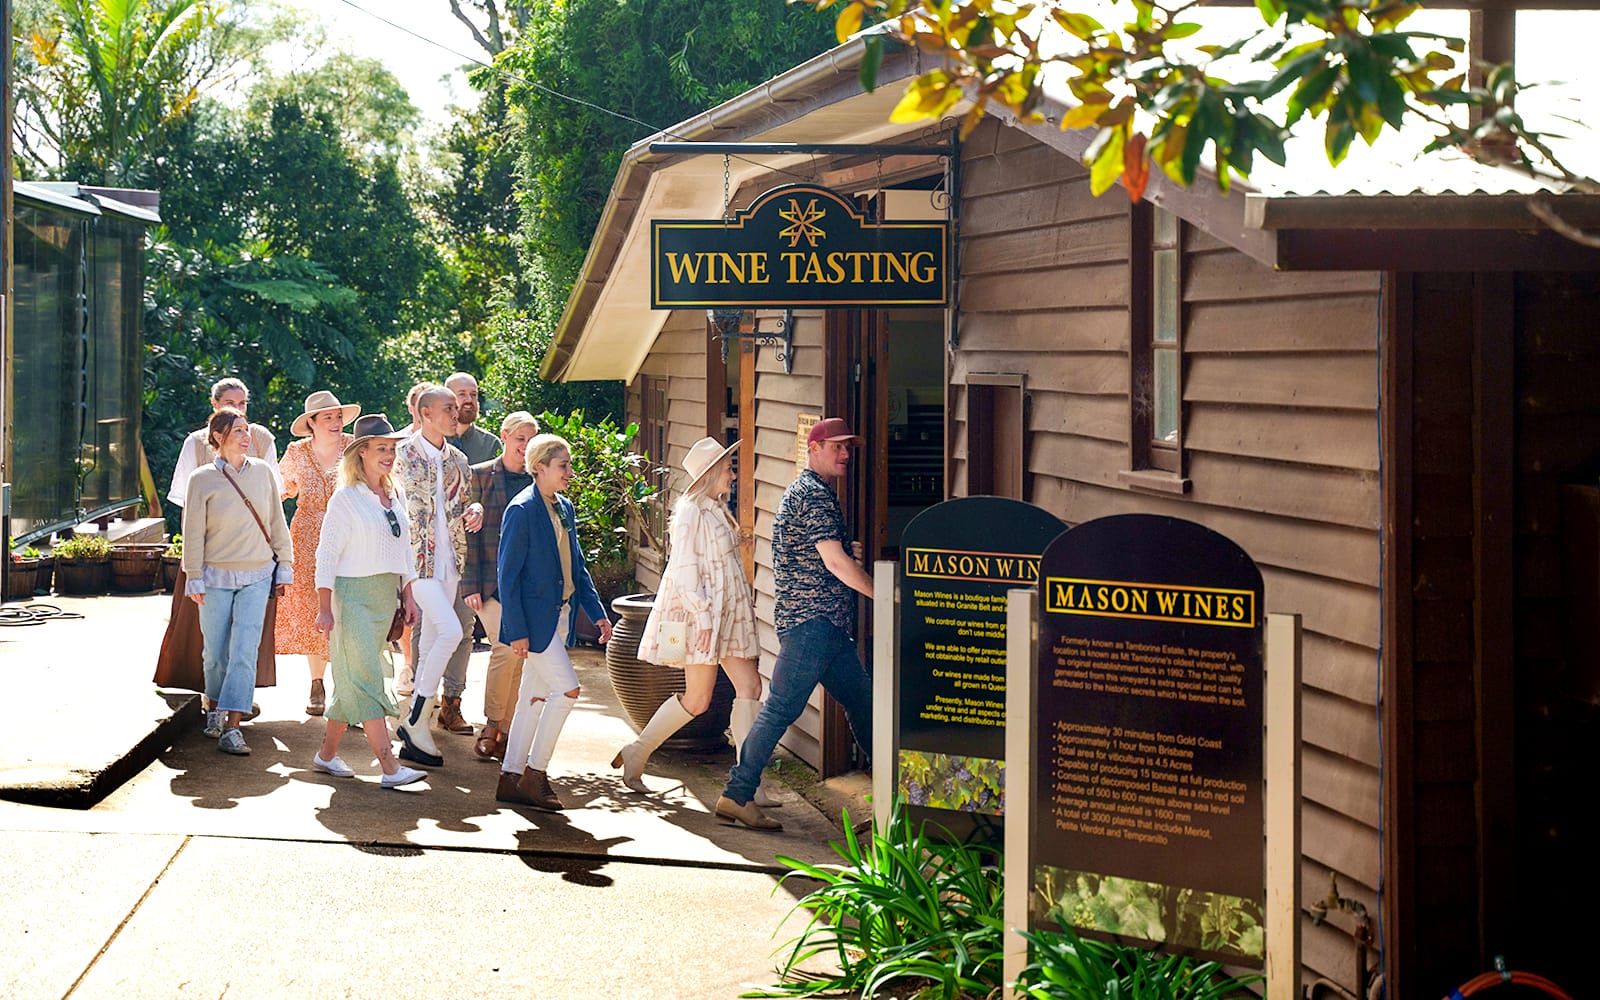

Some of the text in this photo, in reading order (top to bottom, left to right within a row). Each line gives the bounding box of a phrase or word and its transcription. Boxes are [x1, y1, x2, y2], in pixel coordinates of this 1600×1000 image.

[665, 252, 937, 284] WINE TASTING
[914, 553, 1040, 579] MASON WIN
[914, 590, 934, 598] Mason
[934, 592, 952, 600] Wines
[966, 595, 990, 603] boutique
[916, 600, 938, 608] situated
[956, 602, 978, 610] Granite
[979, 603, 990, 611] Belt
[1055, 584, 1245, 621] MASON WINES
[925, 617, 935, 625] We
[986, 630, 1005, 638] middle
[925, 643, 935, 651] We
[1053, 647, 1078, 656] location
[1088, 650, 1108, 658] known
[1121, 653, 1129, 661] Mt
[1173, 659, 1194, 667] oldest
[1062, 636, 1090, 647] Formerly
[1092, 640, 1113, 648] known
[1188, 649, 1199, 657] the
[936, 654, 966, 662] obtainable
[975, 655, 990, 663] retail
[932, 669, 944, 677] Our
[1067, 660, 1090, 669] original
[1140, 666, 1156, 675] back
[1188, 670, 1201, 679] The
[1203, 672, 1216, 681] fruit
[962, 682, 980, 690] grown
[1090, 672, 1104, 680] from
[1106, 674, 1118, 682] this
[1120, 677, 1148, 685] vineyard
[1177, 682, 1201, 690] special
[1203, 685, 1216, 693] and
[964, 699, 984, 707] Mason
[986, 701, 1004, 709] Wines
[1093, 683, 1104, 691] the
[1157, 691, 1177, 699] which
[1188, 694, 1217, 703] beneath
[1219, 697, 1231, 705] the
[957, 706, 968, 714] and
[978, 710, 1000, 718] aspects
[963, 717, 994, 726] distribution
[1058, 721, 1222, 748] Approximately 30 minutes from Gold Coast
[1058, 734, 1110, 749] Approximately
[1120, 742, 1137, 751] hour
[1139, 744, 1157, 753] from
[1158, 746, 1194, 758] Brisbane
[1058, 745, 1076, 756] Total
[1077, 750, 1094, 758] area
[1096, 751, 1106, 759] for
[1155, 759, 1168, 768] 4.5
[1170, 760, 1192, 771] Acres
[1058, 759, 1089, 770] Capable
[1090, 763, 1098, 771] of
[1100, 766, 1138, 779] producing
[1140, 769, 1150, 778] 15
[1152, 772, 1178, 782] tonnes
[1190, 776, 1202, 785] full
[1204, 779, 1247, 791] production
[1058, 771, 1090, 783] Consists
[1091, 776, 1100, 784] of
[1101, 778, 1150, 791] decomposed
[1179, 789, 1188, 797] as
[1198, 791, 1213, 799] rich
[1215, 794, 1228, 802] red
[1230, 796, 1246, 804] soil
[1056, 795, 1088, 809] Average
[1090, 802, 1116, 812] annual
[1117, 806, 1143, 815] rainfall
[1176, 814, 1190, 822] mm
[1096, 788, 1110, 798] 500
[1112, 791, 1120, 800] to
[1138, 796, 1165, 806] metres
[1168, 799, 1192, 810] above
[1194, 804, 1208, 813] sea
[1210, 804, 1230, 815] level
[1064, 810, 1080, 819] total
[1081, 812, 1090, 821] of
[1112, 816, 1136, 828] plants
[1154, 823, 1182, 835] include
[1080, 824, 1104, 836] Verdot
[1106, 829, 1121, 838] and
